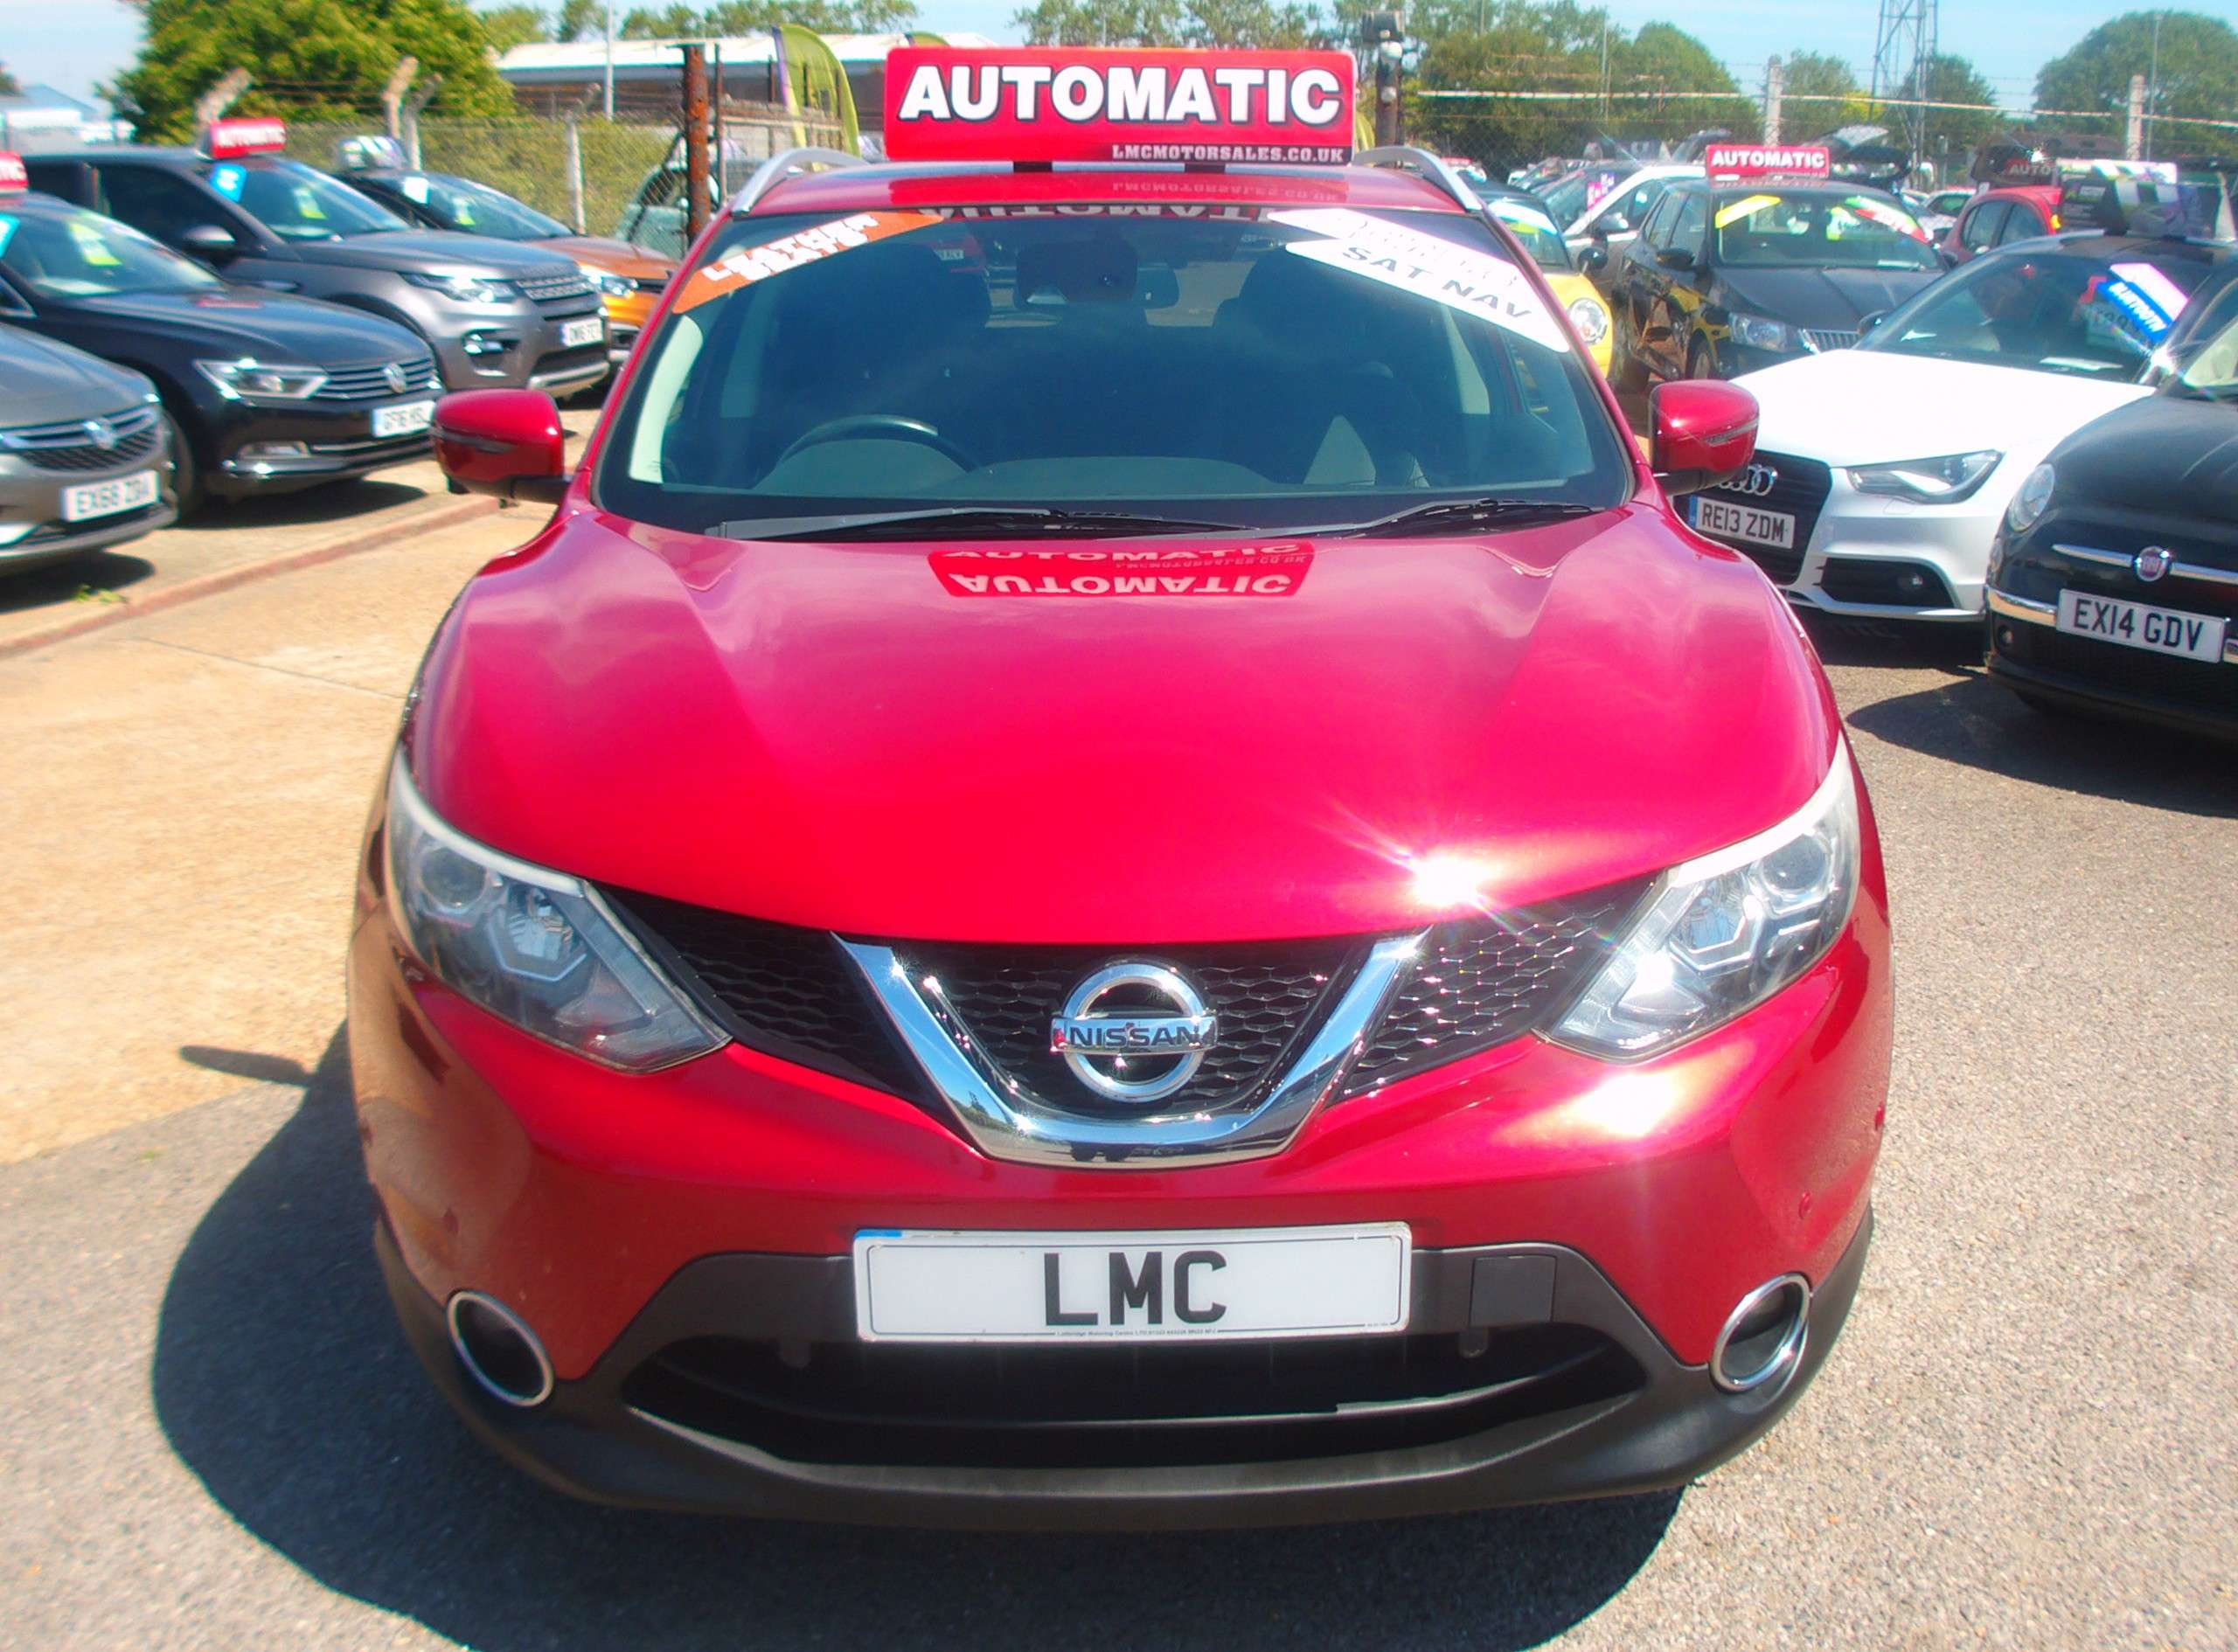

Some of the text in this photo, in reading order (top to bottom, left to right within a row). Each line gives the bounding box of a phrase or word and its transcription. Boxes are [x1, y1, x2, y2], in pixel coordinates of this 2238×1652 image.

[898, 65, 1342, 125] AUTOMATIC
[1111, 144, 1344, 163] LMCMOTORSALES.CO.UK
[1711, 150, 1825, 169] AUTOMATIC
[1342, 246, 1434, 280] SAT
[1442, 278, 1533, 318] NAV
[1701, 503, 1785, 543] RE13 ZDM
[2073, 599, 2204, 652] EX14 GDV
[1069, 1025, 1201, 1047] NISSAN
[1043, 1250, 1228, 1327] LMC
